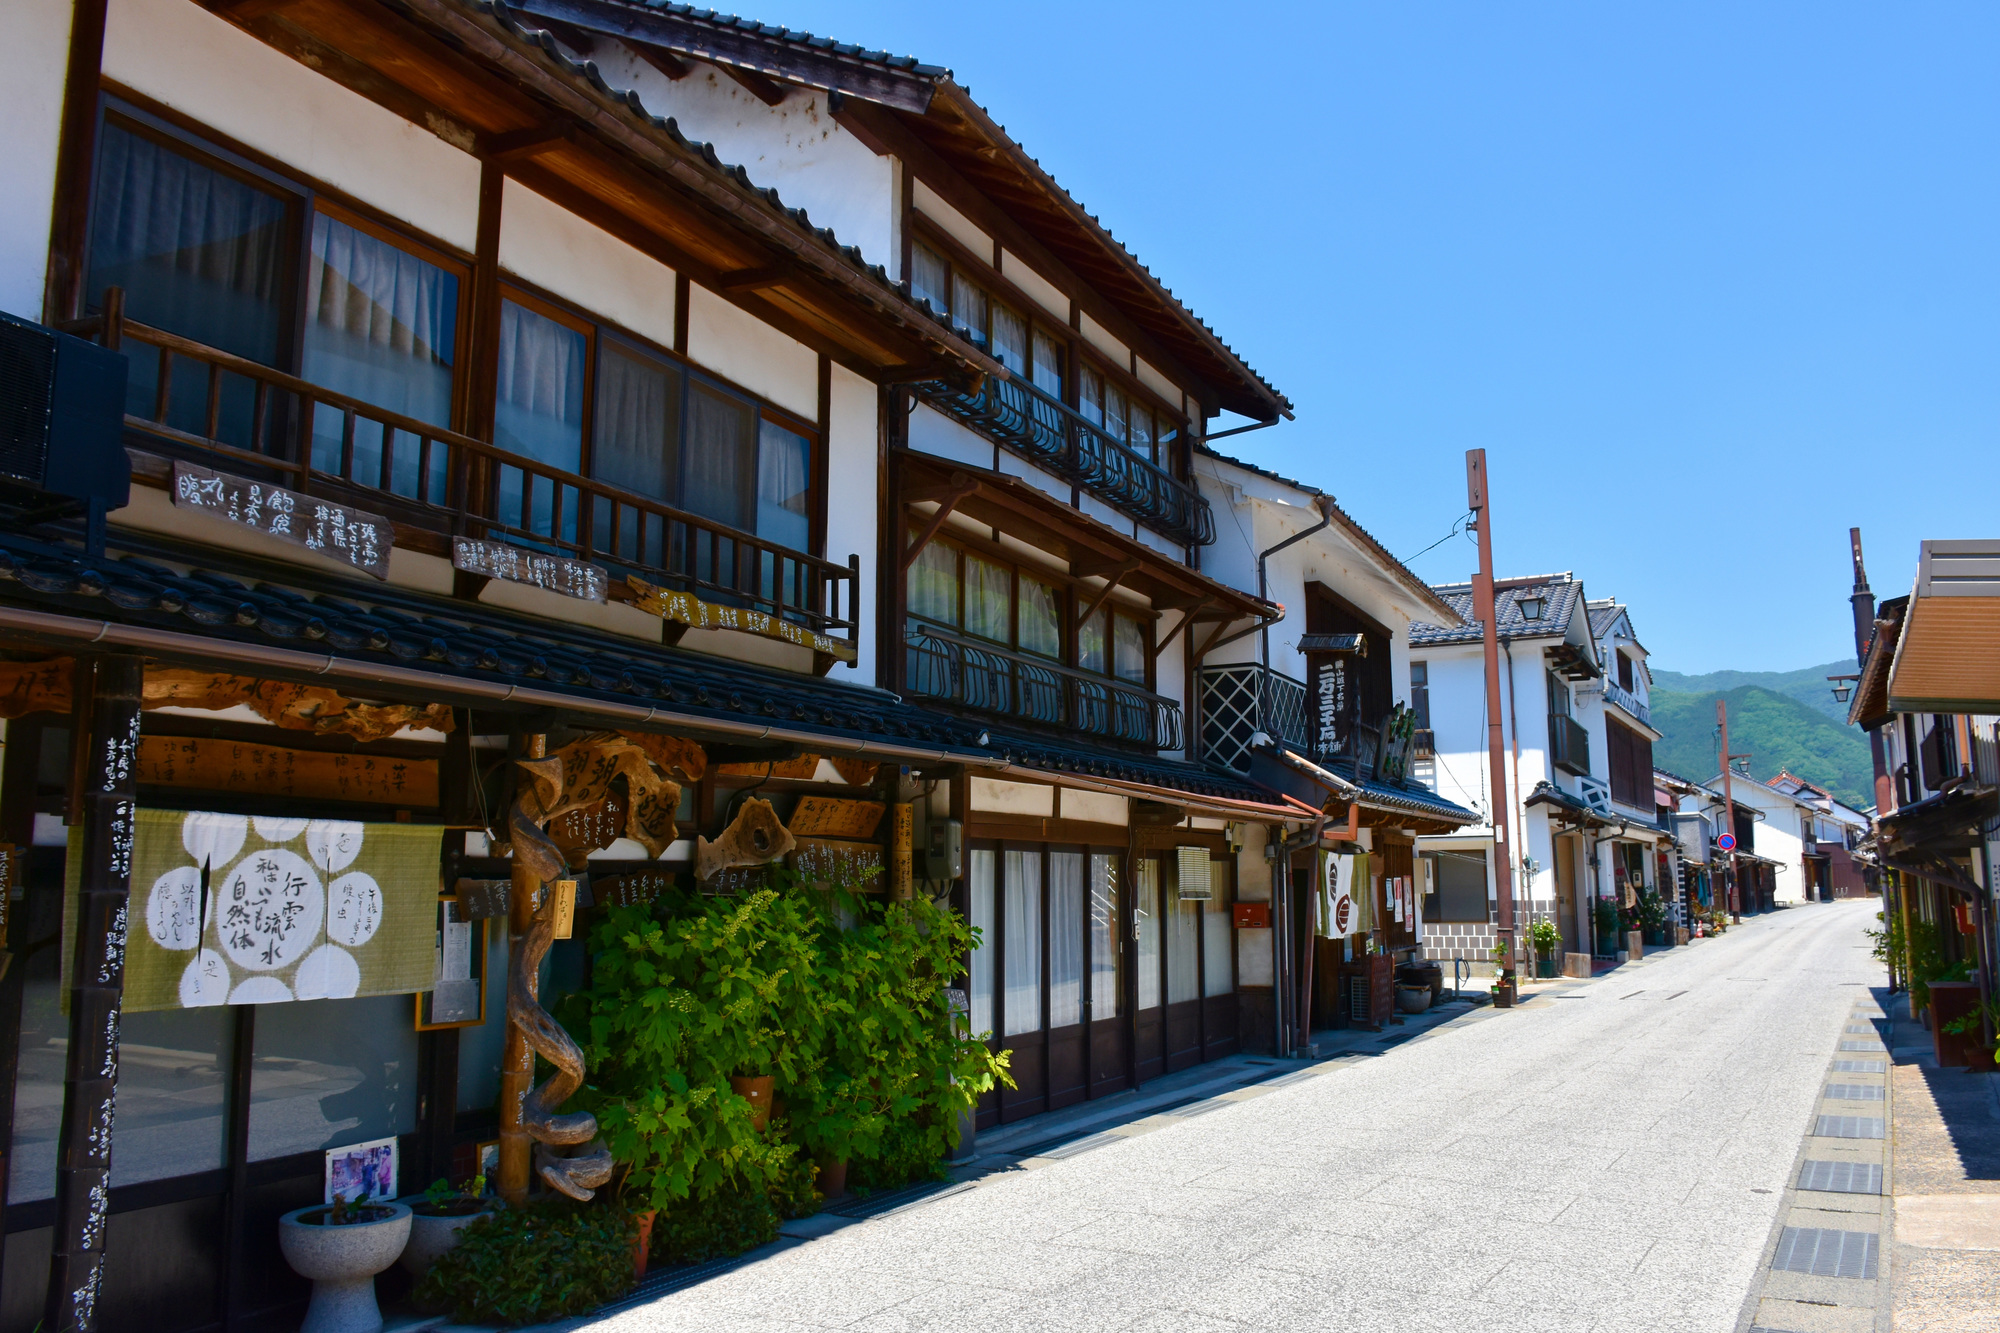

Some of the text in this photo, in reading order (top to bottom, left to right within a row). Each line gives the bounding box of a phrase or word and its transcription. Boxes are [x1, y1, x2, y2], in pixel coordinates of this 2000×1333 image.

[330, 508, 347, 548] 通帳
[1318, 663, 1336, 741] 二万三千石
[222, 873, 255, 950] 自然体
[281, 871, 308, 931] 行雲
[260, 912, 286, 965] 流水
